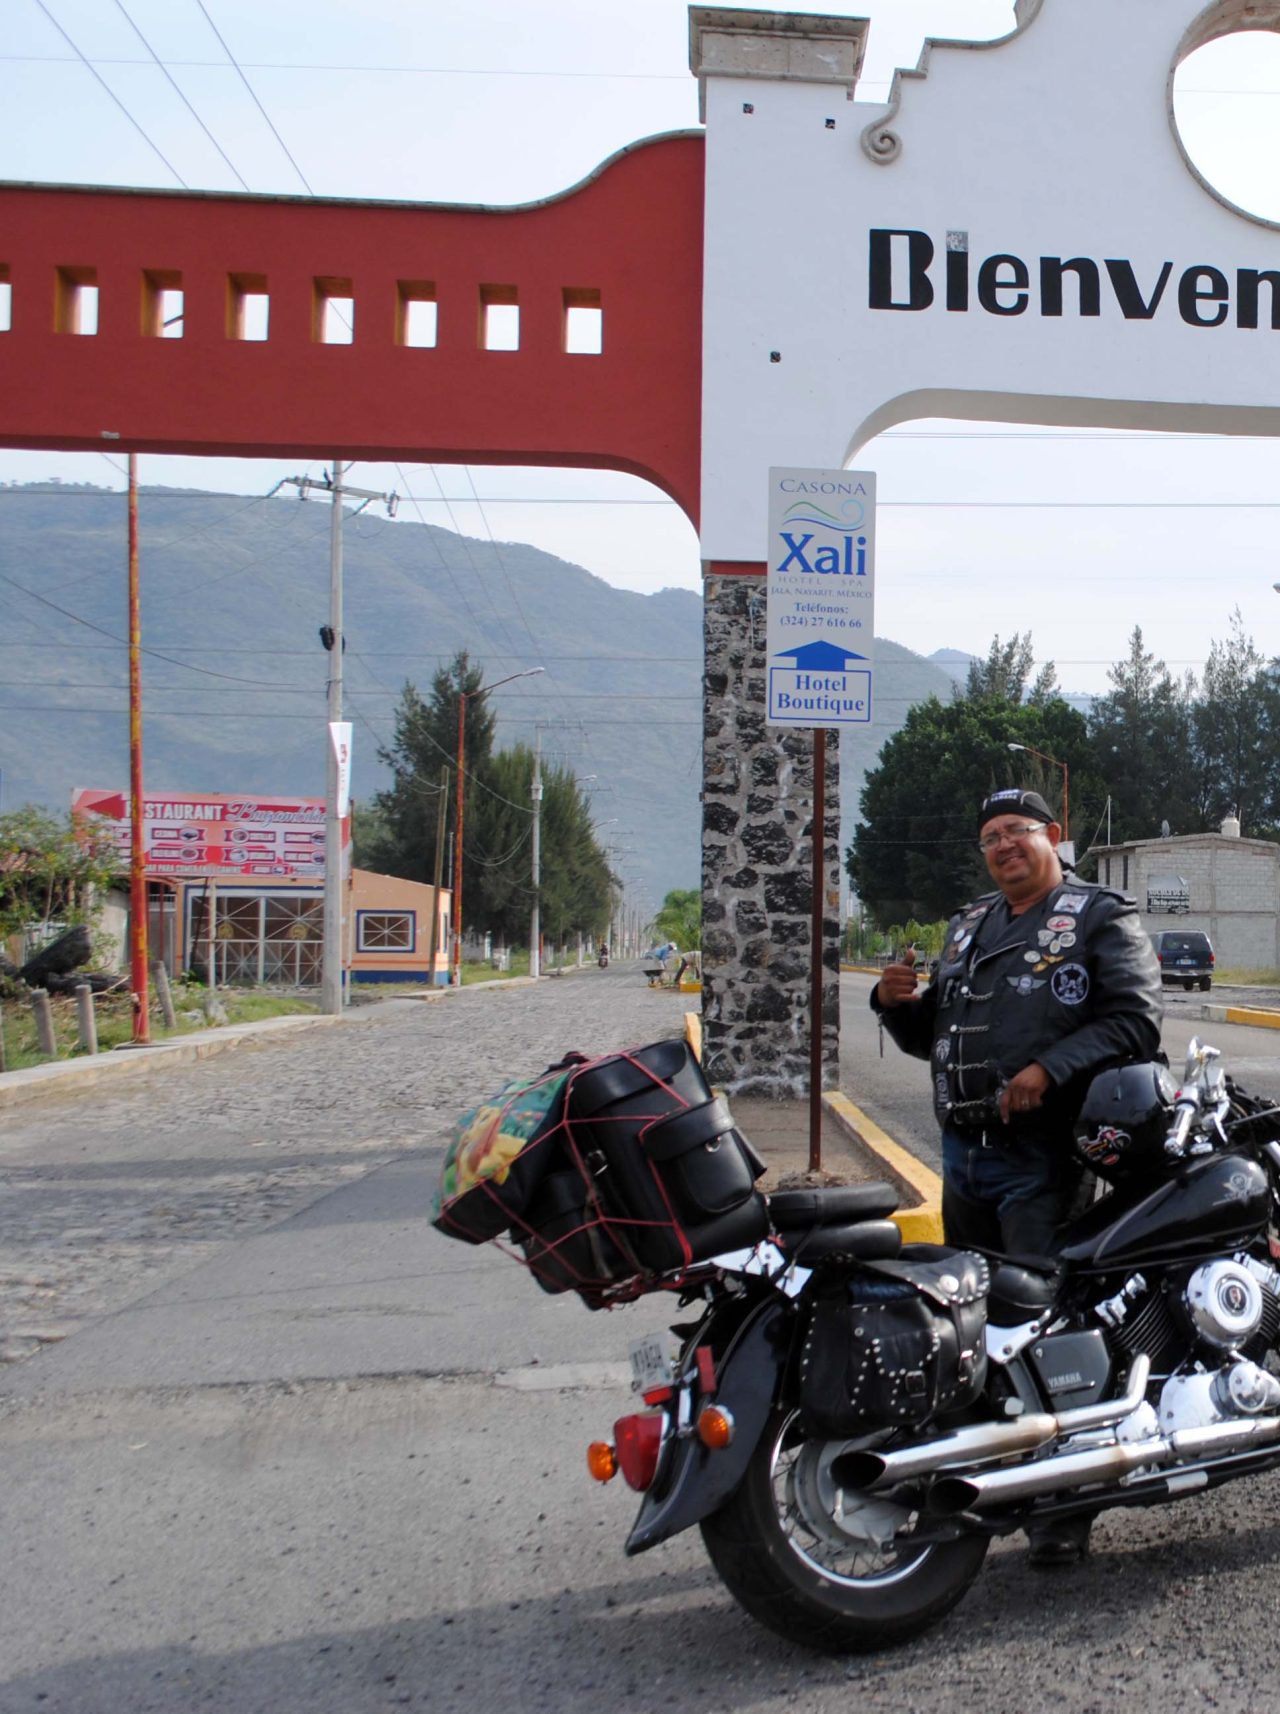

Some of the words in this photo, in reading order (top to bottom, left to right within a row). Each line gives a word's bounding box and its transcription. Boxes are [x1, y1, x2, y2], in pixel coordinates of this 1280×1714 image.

[780, 478, 867, 495] CASONA
[776, 532, 868, 576] Xali
[778, 575, 822, 586] HOTEL
[841, 578, 863, 587] SPA
[794, 602, 849, 615] Teléfonos:
[780, 615, 808, 627] (324)
[811, 617, 825, 627] 27
[826, 618, 846, 628] 616
[849, 618, 863, 628] 66
[795, 674, 847, 692] Hotel
[777, 693, 865, 715] Boutique
[126, 801, 223, 821] RSTAURANT
[1048, 1371, 1082, 1388] YAMAHA
